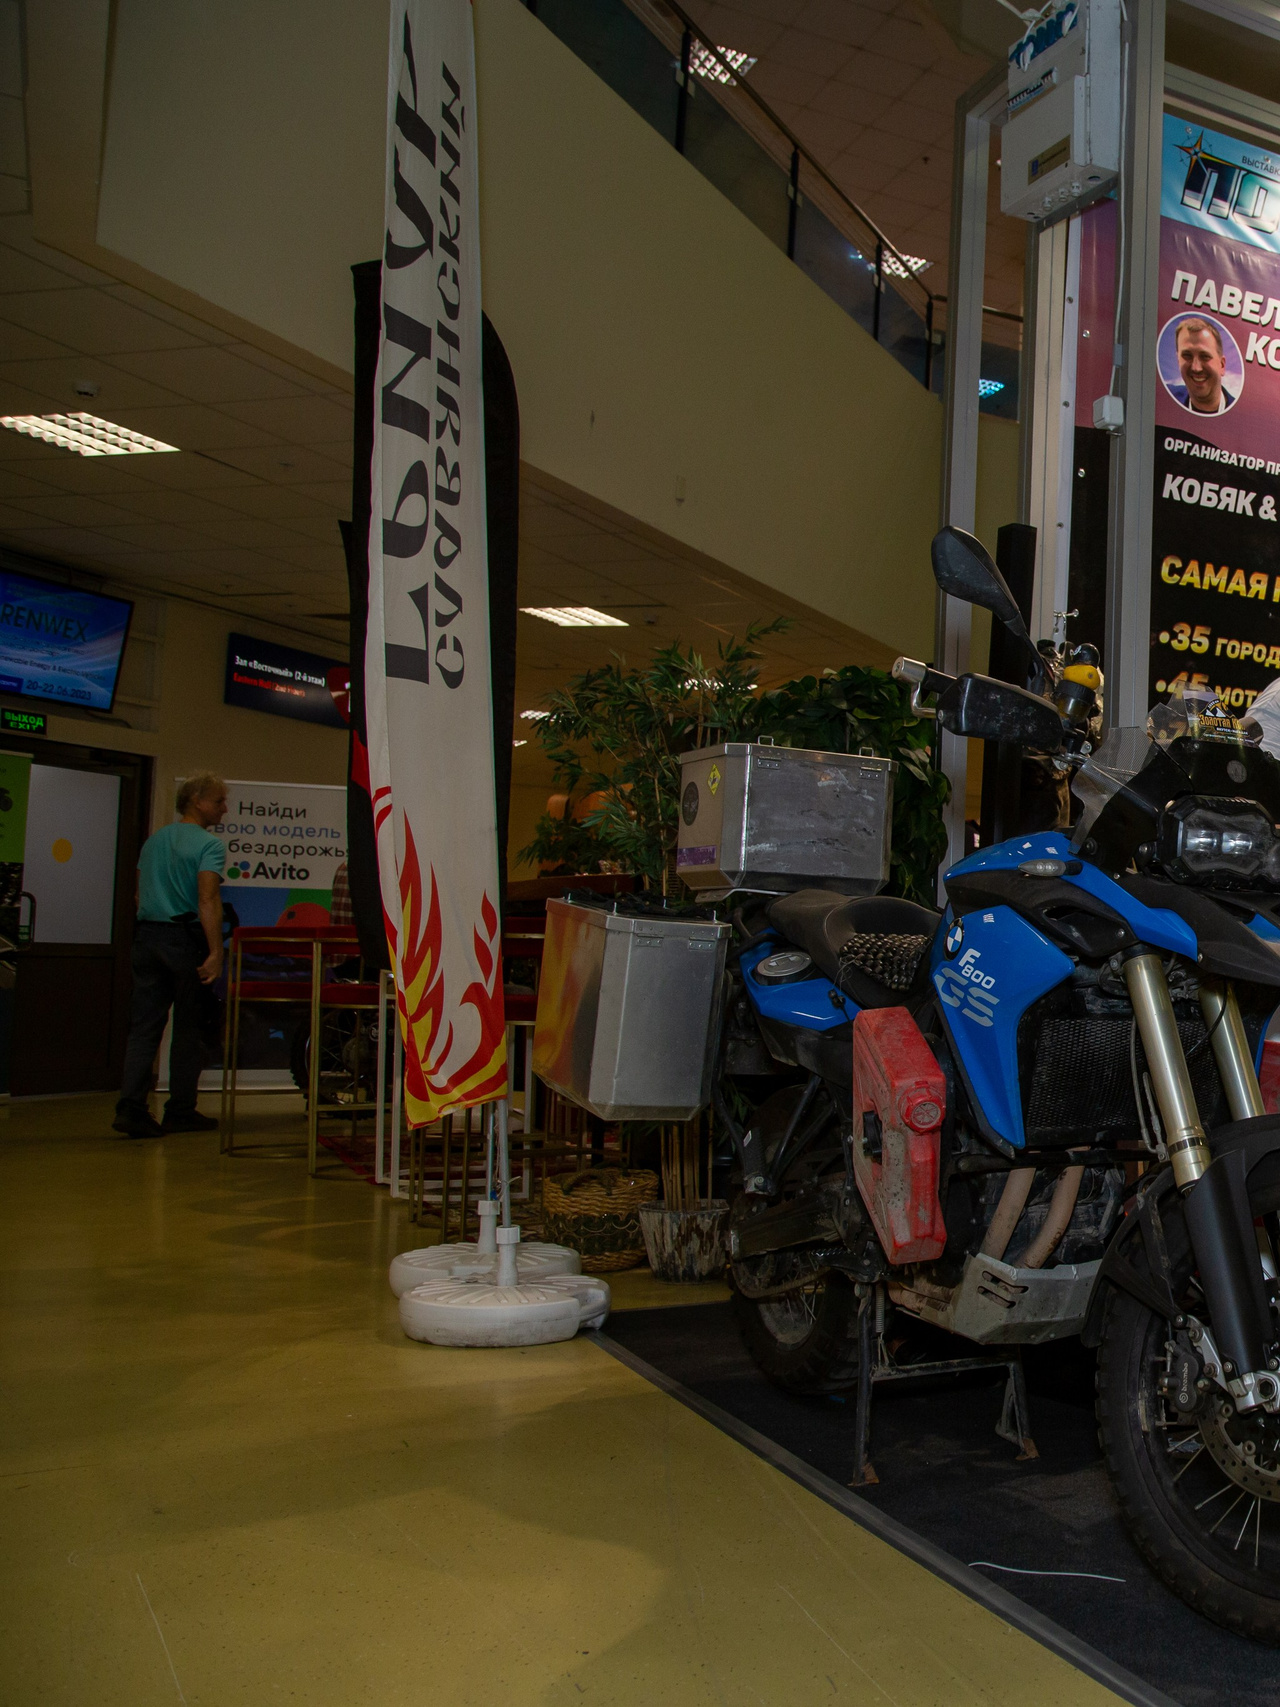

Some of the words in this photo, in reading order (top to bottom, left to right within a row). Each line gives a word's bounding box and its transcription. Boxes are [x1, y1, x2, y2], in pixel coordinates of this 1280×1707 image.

[1163, 436, 1265, 472] ОРГАНИЗАТОР
[1162, 472, 1258, 518] КОБЯК
[1258, 494, 1278, 522] &
[1160, 554, 1270, 603] САМАЯ
[0, 602, 89, 643] RENWEX
[234, 655, 248, 668] Зал
[4, 711, 44, 728] ВЫХОД
[9, 720, 37, 732] EXIT
[239, 801, 307, 820] Найди
[263, 824, 341, 839] модель
[228, 838, 350, 859] бездорожь
[252, 861, 310, 881] Avito
[958, 947, 982, 968] F
[961, 964, 996, 990] 800
[1180, 1362, 1189, 1392] brembo
